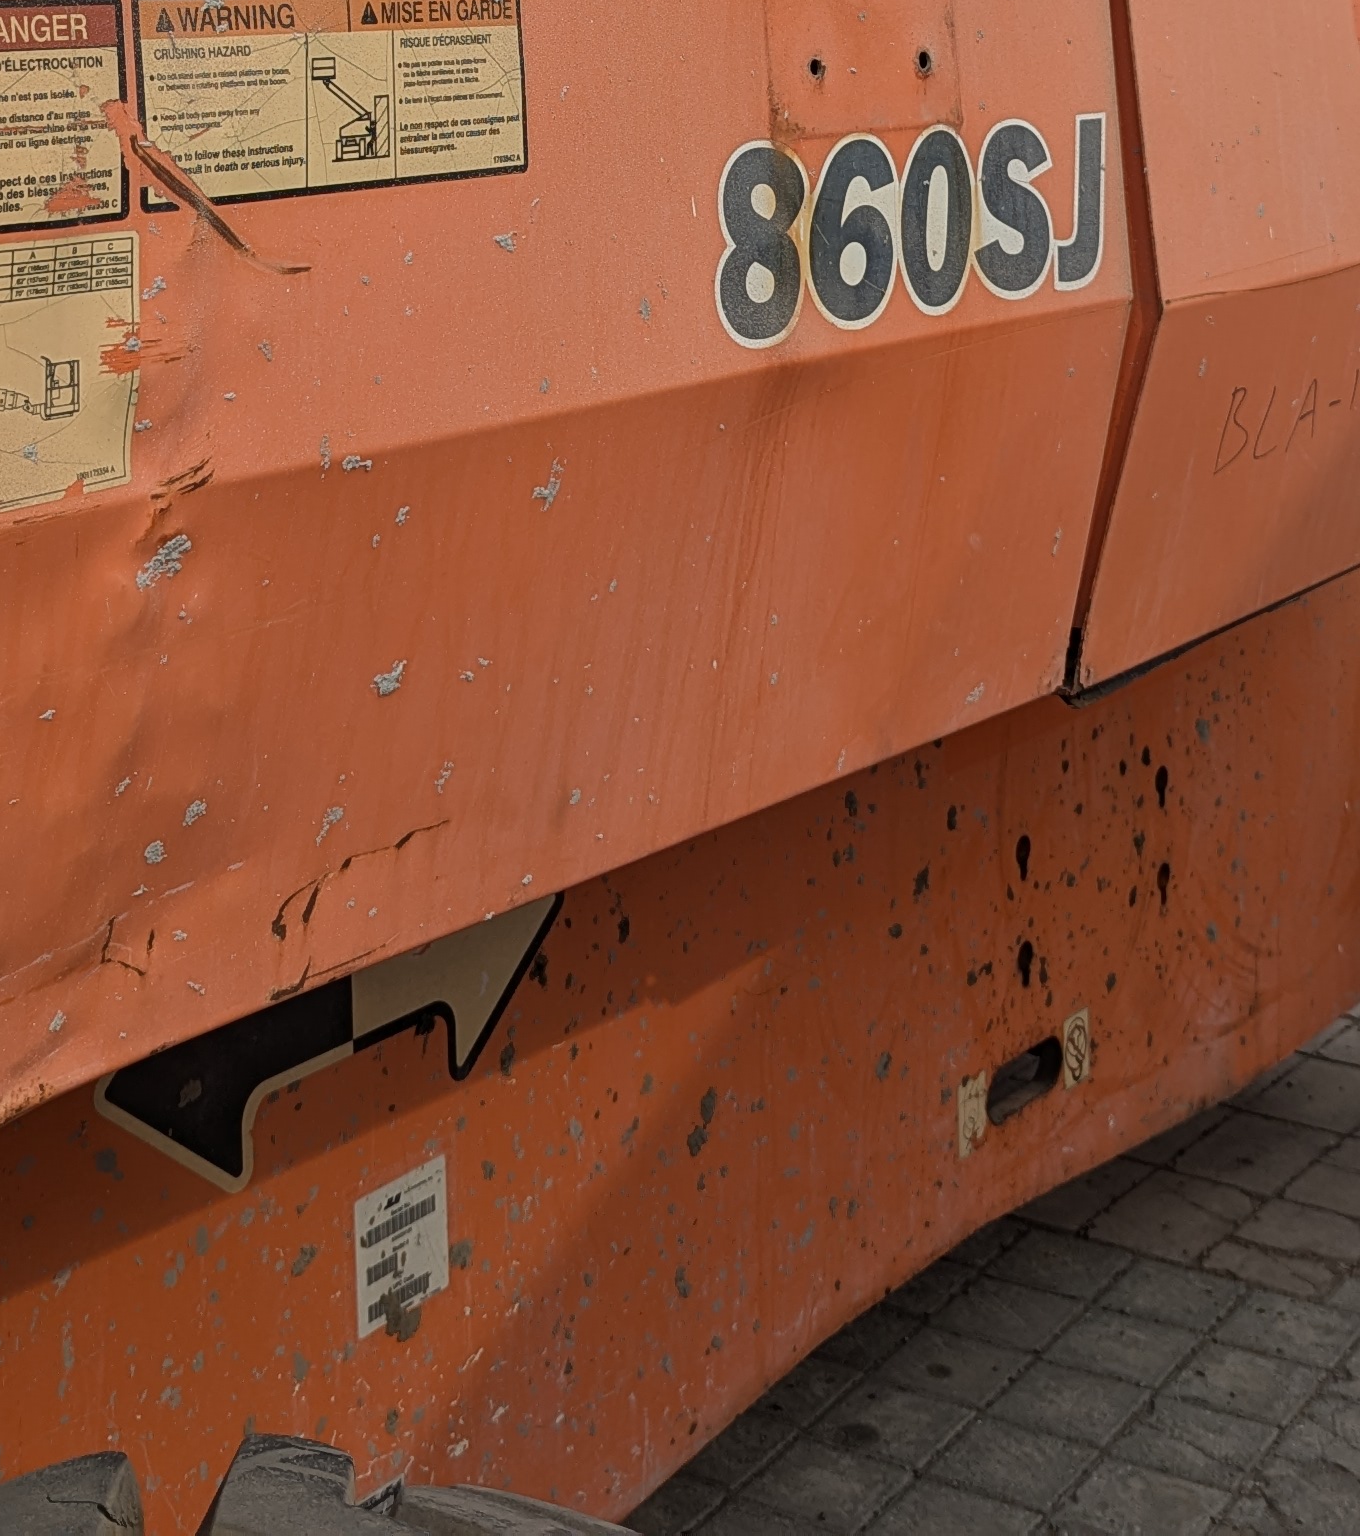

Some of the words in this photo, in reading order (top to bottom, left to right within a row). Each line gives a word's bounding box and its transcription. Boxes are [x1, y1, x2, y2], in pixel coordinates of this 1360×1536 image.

[176, 3, 295, 33] WARNING
[381, 0, 424, 24] MISE
[429, 0, 452, 23] EN
[400, 35, 431, 49] RISQUE
[432, 33, 492, 47] D'ÉCRASEMENT
[154, 47, 206, 61] CRUSHING
[208, 45, 252, 58] HAZARD
[11, 92, 31, 102] n'est
[33, 93, 48, 102] pas
[9, 113, 44, 123] distance
[46, 111, 63, 120] d'au
[400, 122, 408, 131] Le
[410, 122, 423, 130] non
[424, 119, 449, 130] respect
[450, 118, 459, 126] de
[15, 140, 26, 149] ou
[28, 138, 49, 149] ligne
[184, 152, 193, 161] to
[195, 149, 221, 161] follow
[222, 147, 246, 159] these
[247, 144, 293, 156] instructions
[205, 163, 212, 173] in
[214, 161, 238, 173] death
[240, 161, 250, 171] or
[251, 158, 280, 169] serious
[282, 156, 306, 168] injury.
[24, 175, 36, 185] de
[39, 175, 57, 184] ces
[7, 189, 24, 200] des
[111, 199, 118, 208] C
[715, 112, 1107, 350] 860SJ
[28, 251, 36, 260] A
[72, 246, 78, 255] B
[107, 243, 114, 251] C
